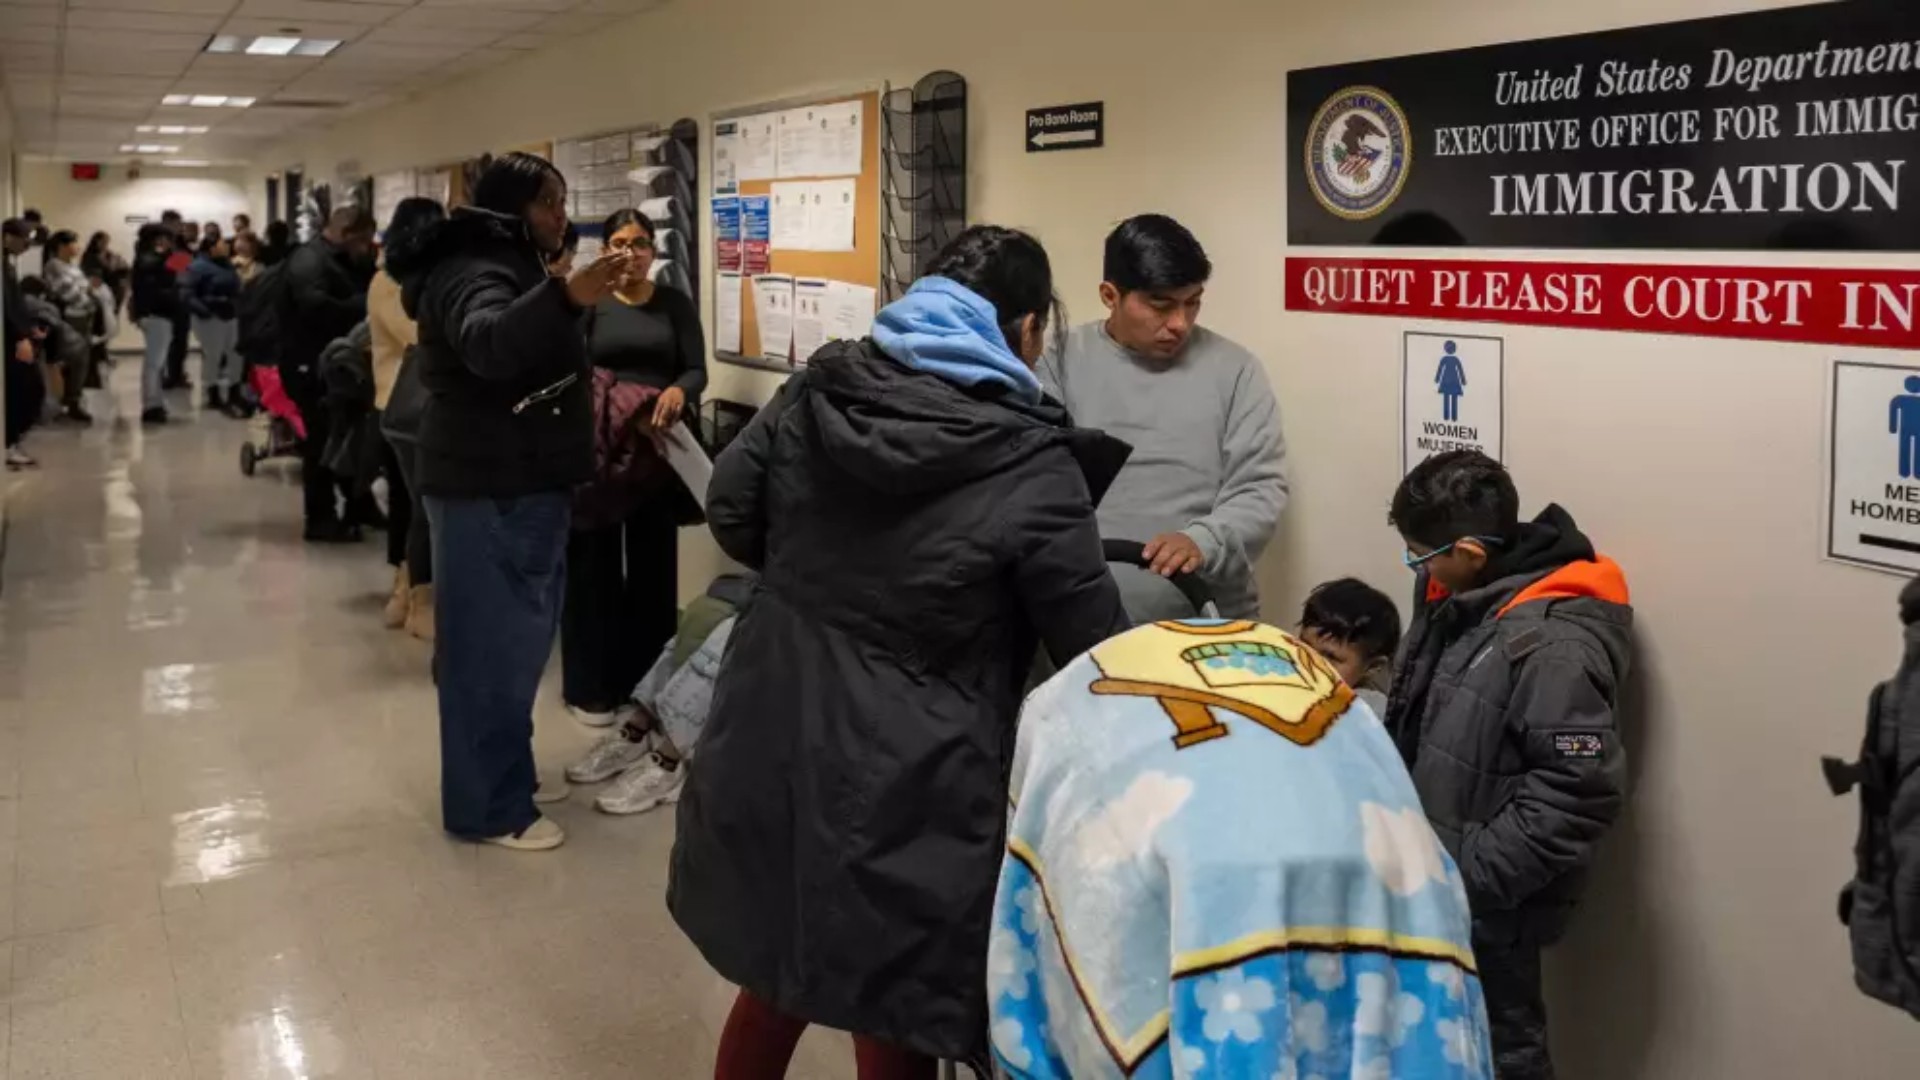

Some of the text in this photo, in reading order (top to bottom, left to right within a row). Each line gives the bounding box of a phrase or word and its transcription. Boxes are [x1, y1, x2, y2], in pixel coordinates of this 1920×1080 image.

[1496, 64, 1583, 105] United
[1595, 58, 1692, 98] States
[1029, 110, 1098, 128] Pro Bono Room
[1435, 93, 1920, 156] EXECUTIVE OFFICE FOR IMMIG
[1489, 159, 1906, 215] IMMIGRATION
[1303, 266, 1920, 331] QUIET PLEASE COURT IN
[1423, 421, 1478, 440] WOMEN
[1850, 498, 1920, 525] HOMB
[1885, 483, 1920, 503] ME
